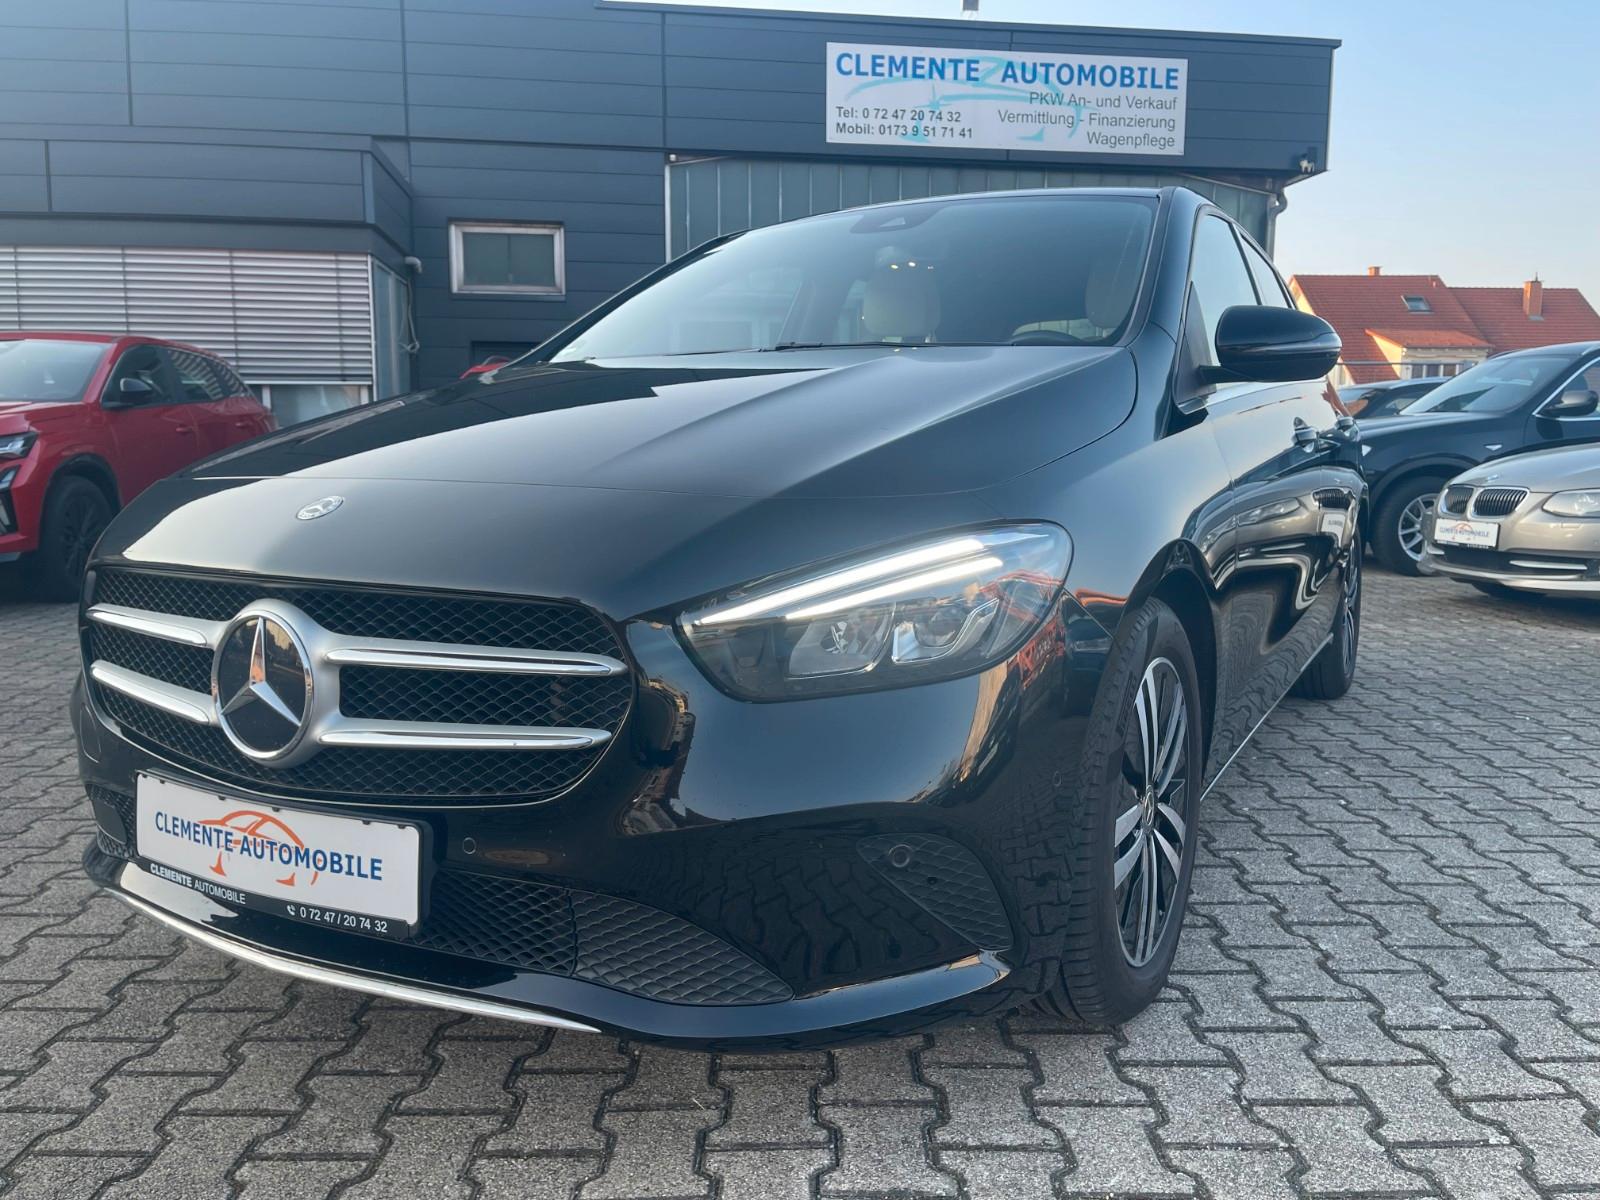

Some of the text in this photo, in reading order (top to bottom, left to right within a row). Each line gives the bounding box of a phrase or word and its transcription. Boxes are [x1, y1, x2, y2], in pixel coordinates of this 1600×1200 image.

[836, 52, 1179, 90] CLEMENTE AUTOMOBILE
[1029, 92, 1177, 110] PKW An- und Verkauf
[836, 106, 961, 123] Tel: 0 72 47 20 74 32
[998, 109, 1075, 128] Vermittlung
[1088, 112, 1176, 132] Finanzierung
[836, 122, 973, 139] Mobil: 0173 9 51 71 41
[1086, 131, 1175, 150] Wagenpflege
[155, 811, 382, 881] CLEMENTE AUTOMOBILE
[150, 863, 246, 905] CLEMENTE AUTOMOBILE
[300, 906, 306, 918] 0
[309, 908, 321, 921] 72
[323, 911, 335, 923] 47
[343, 914, 356, 927] 20
[359, 917, 371, 929] 74
[374, 920, 388, 932] 32
